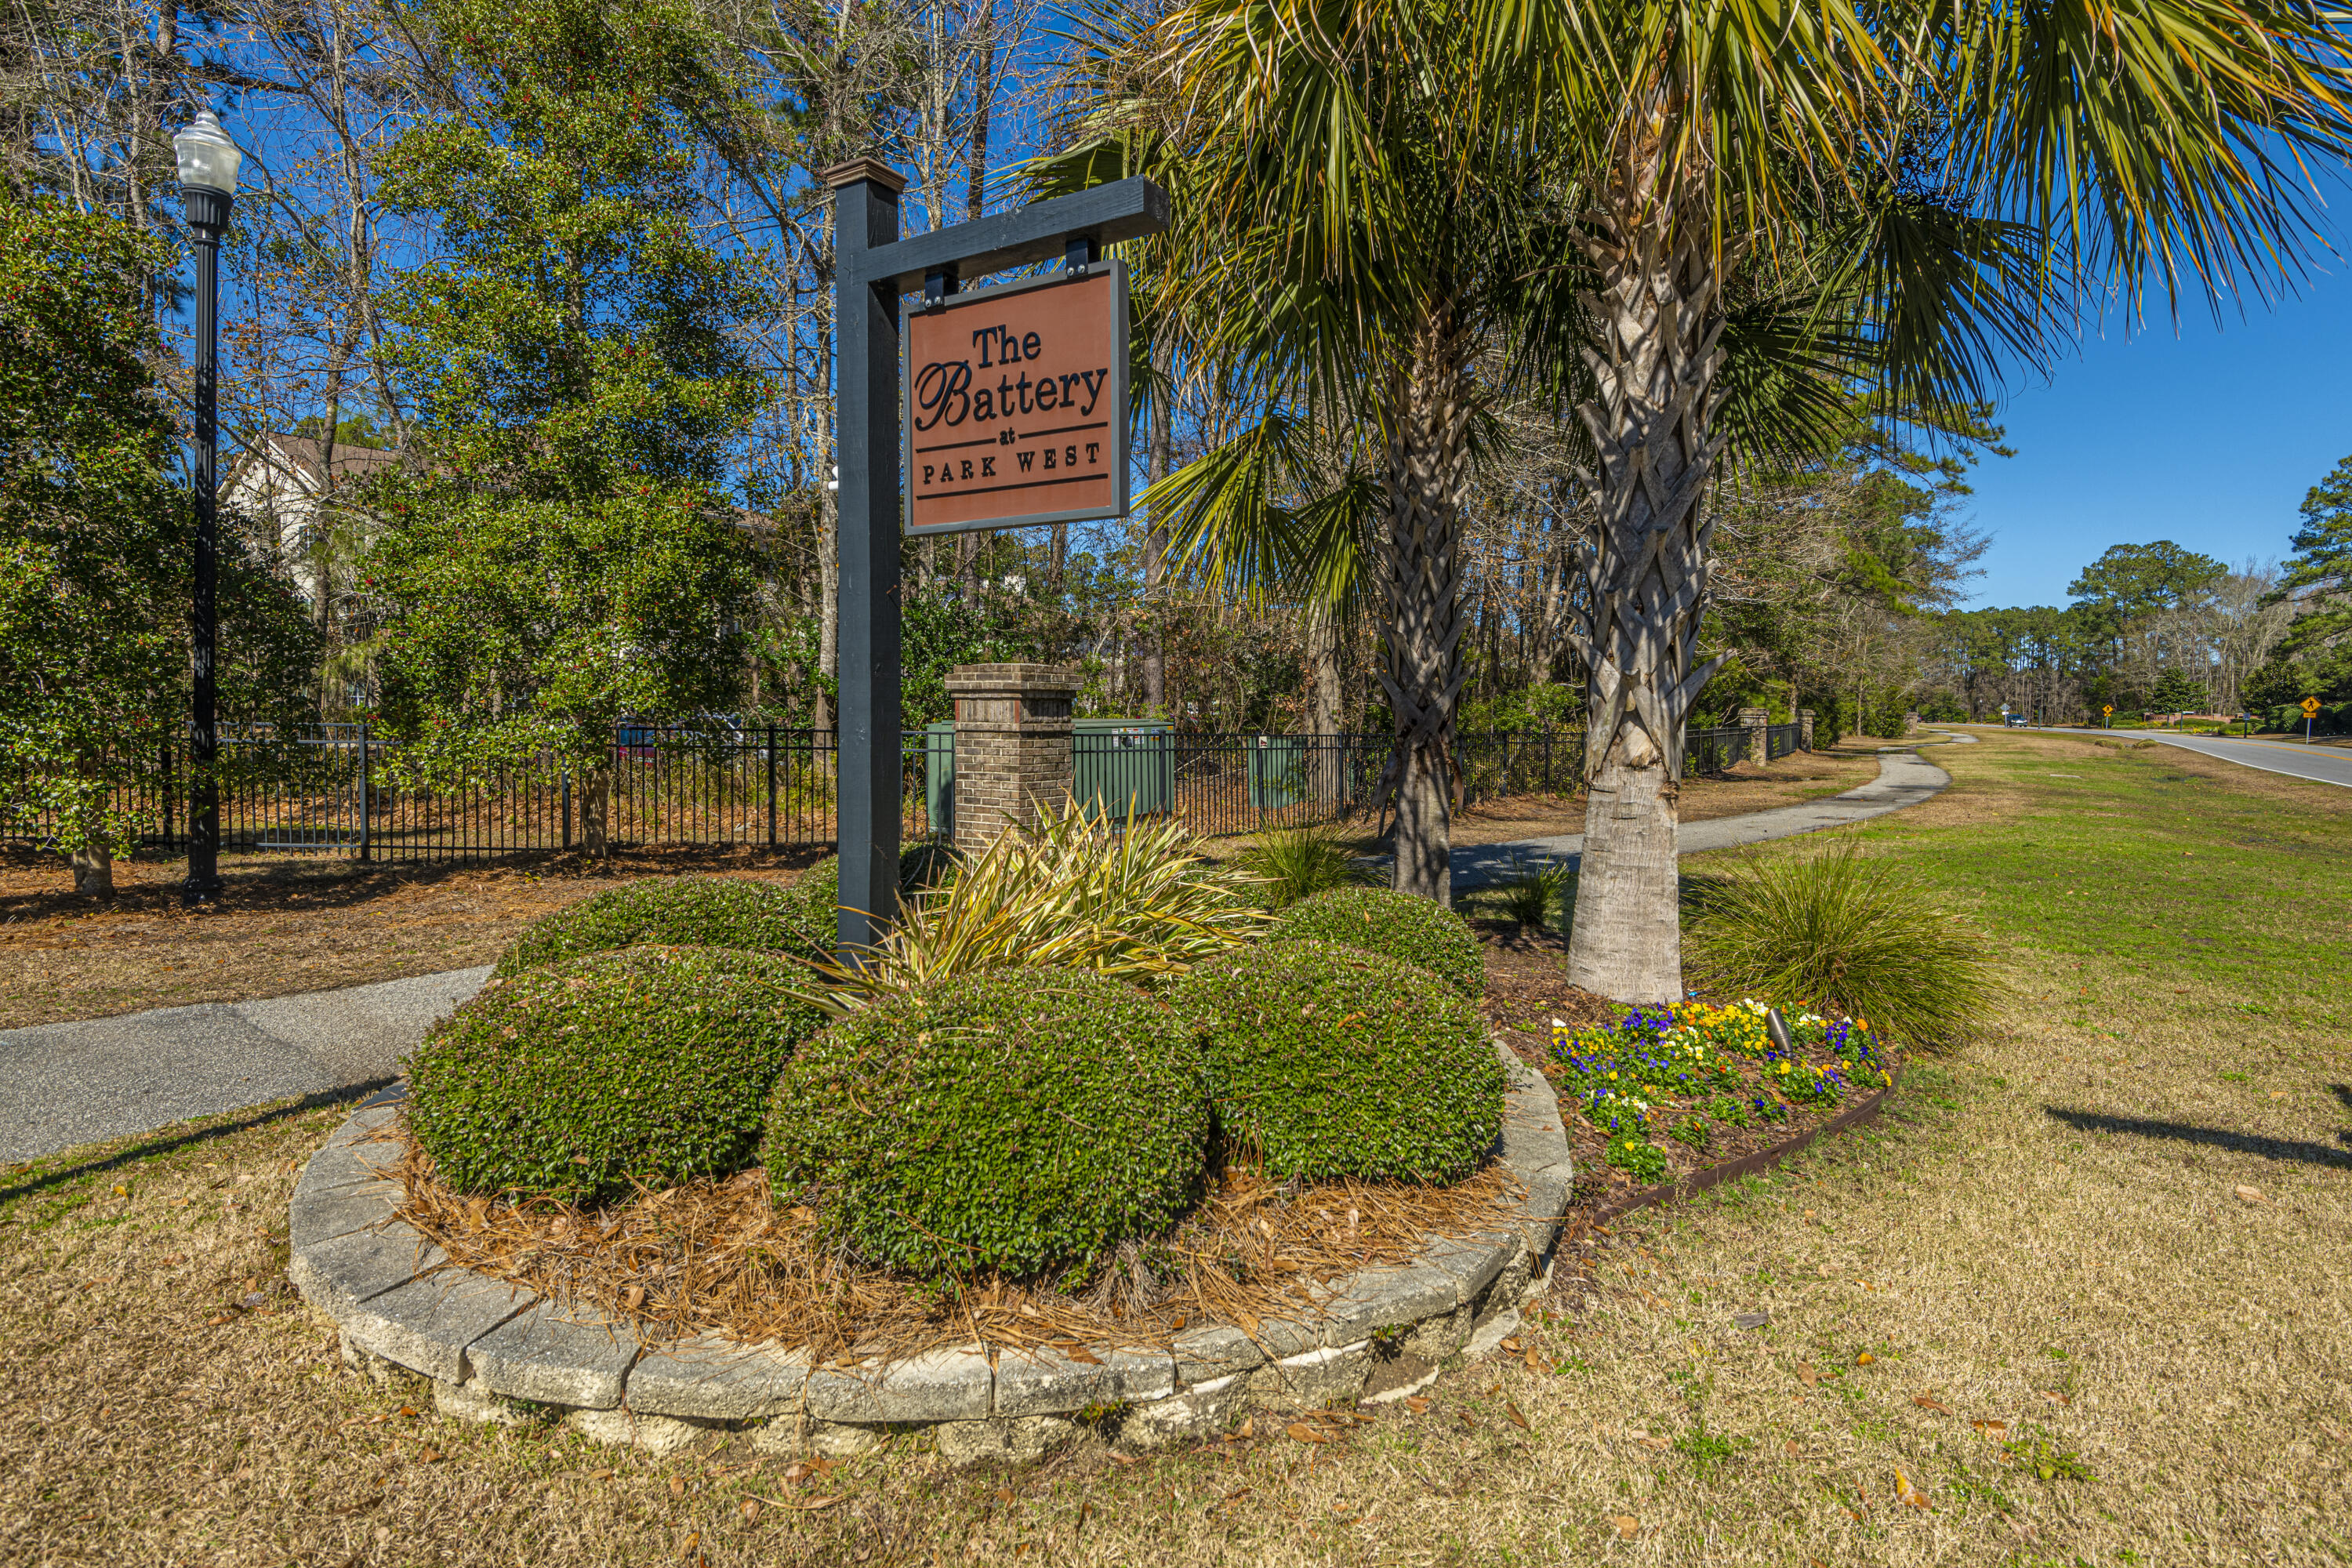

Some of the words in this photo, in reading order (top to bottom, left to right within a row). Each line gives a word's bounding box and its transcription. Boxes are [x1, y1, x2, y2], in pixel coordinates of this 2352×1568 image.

[972, 324, 1042, 369] The
[913, 359, 1109, 432] Battery
[999, 426, 1016, 446] at
[922, 456, 997, 485] PARK
[1015, 442, 1100, 474] WEST
